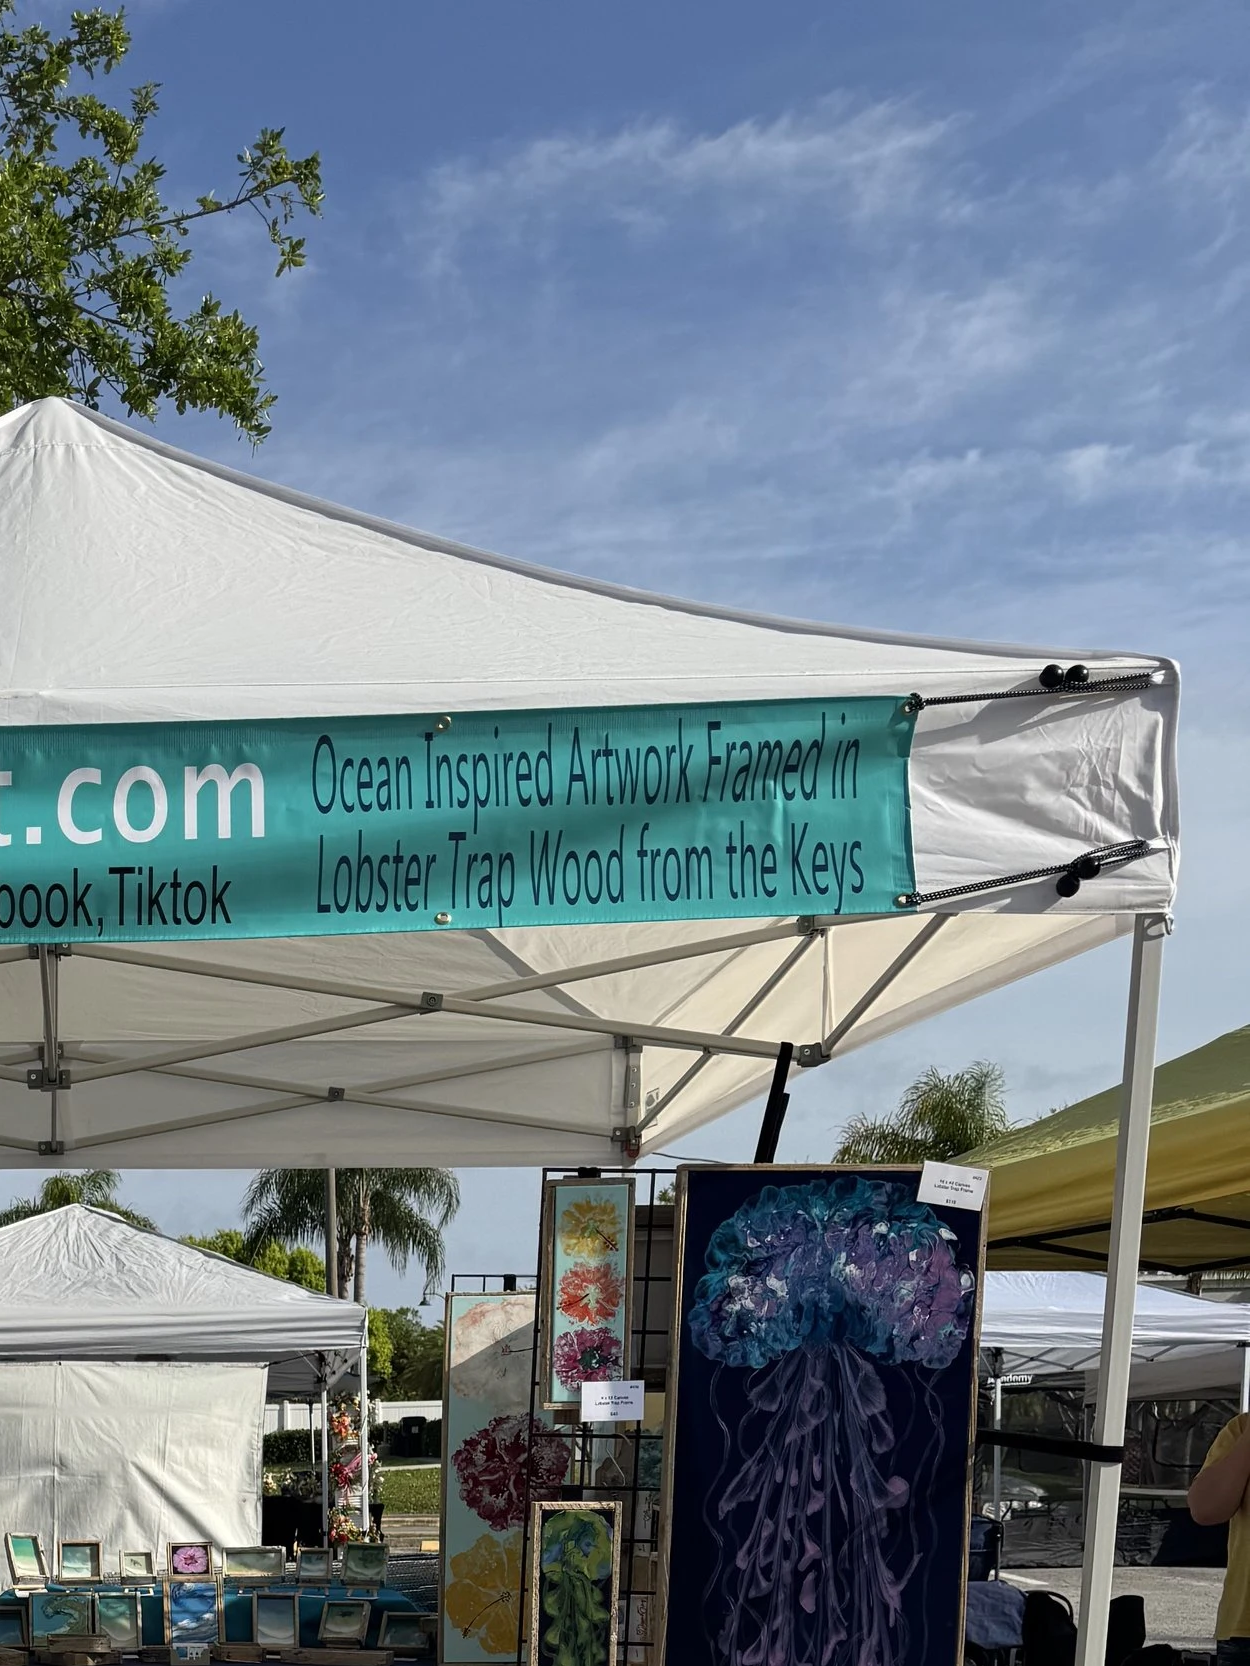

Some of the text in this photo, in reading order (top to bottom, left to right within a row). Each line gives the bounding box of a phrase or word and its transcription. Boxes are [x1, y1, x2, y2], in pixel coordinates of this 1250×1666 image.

[311, 711, 861, 835] Ocean Inspired Artwork Framed in
[316, 820, 865, 928] Lobster Trap Wood from the Keys
[987, 1374, 1034, 1385] Aademy
